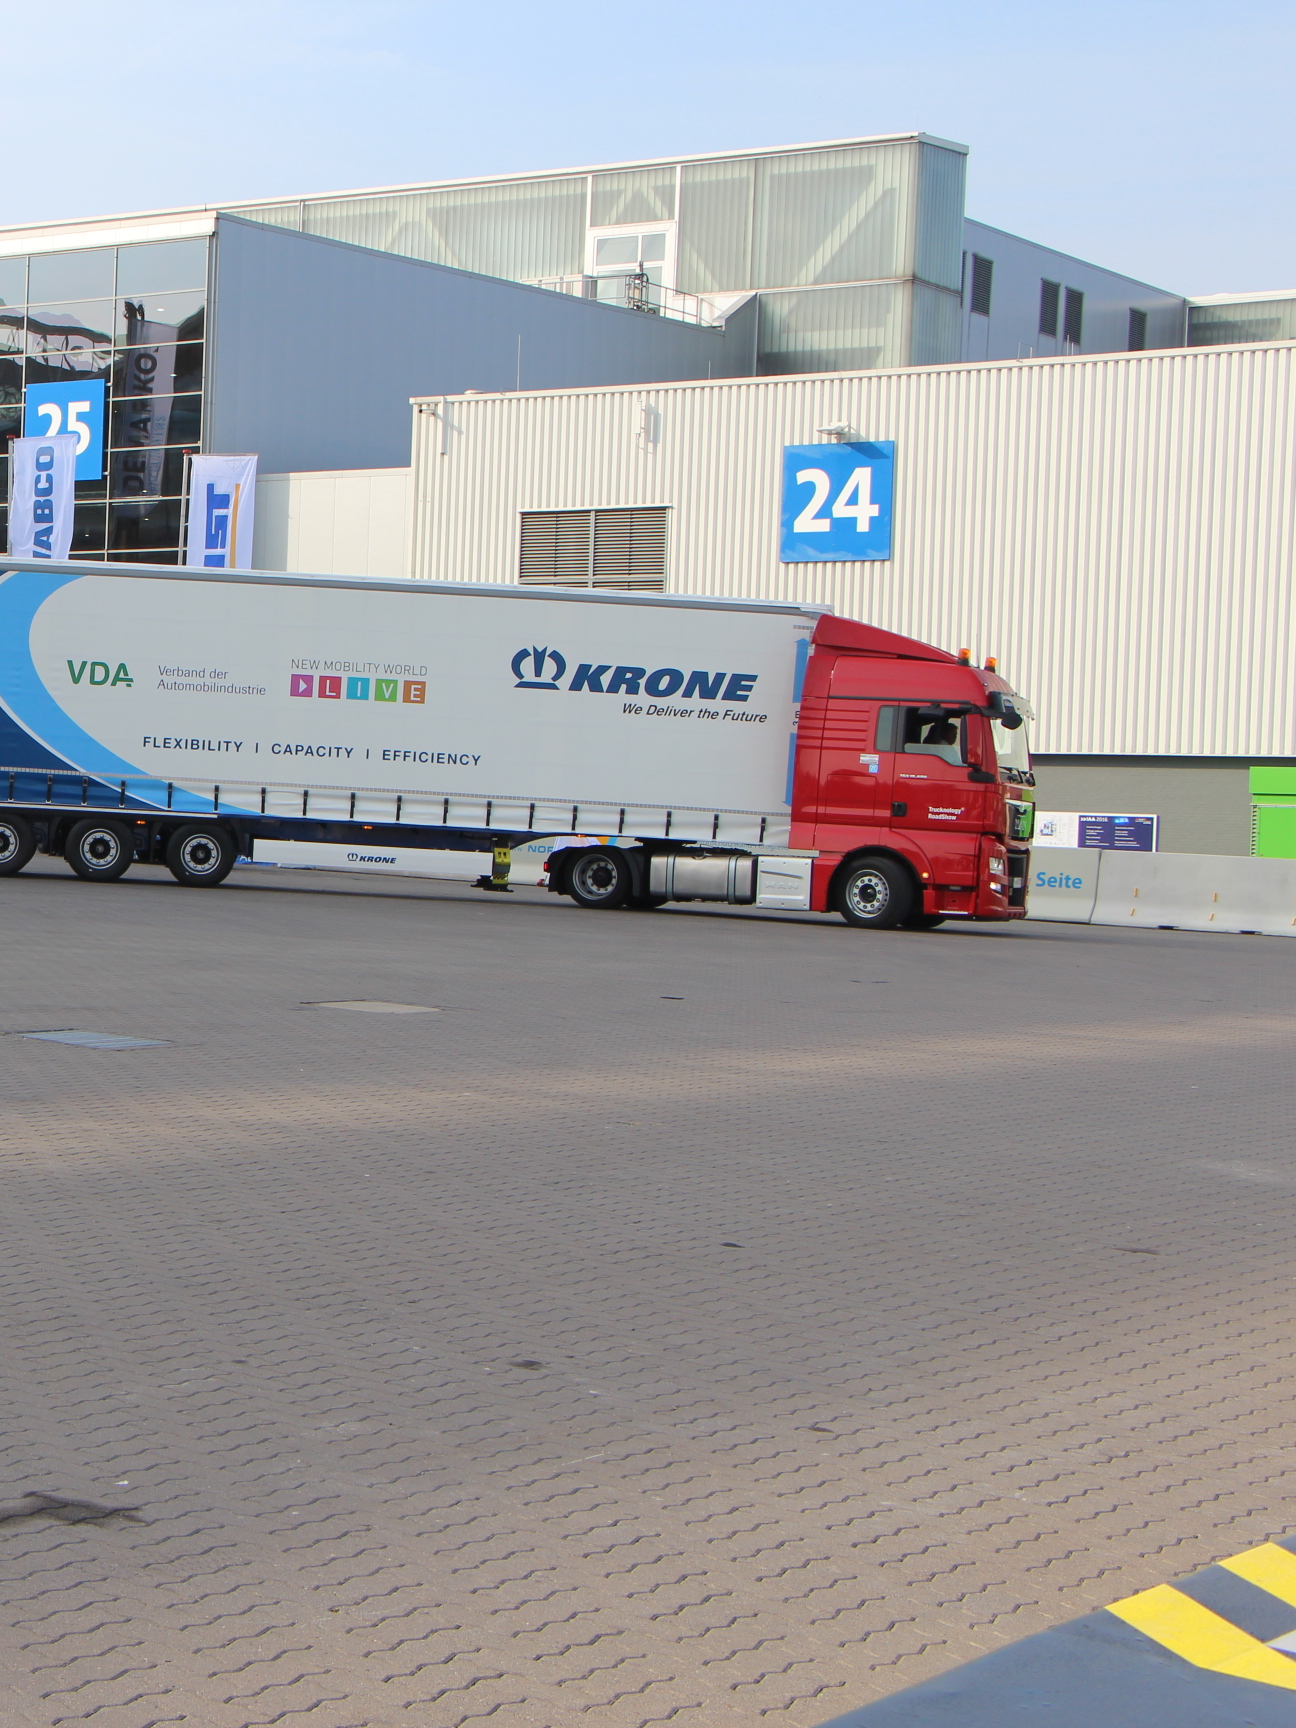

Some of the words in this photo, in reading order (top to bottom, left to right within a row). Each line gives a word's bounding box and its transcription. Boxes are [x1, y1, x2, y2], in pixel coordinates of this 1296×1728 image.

[37, 401, 91, 457] 25
[793, 466, 880, 533] 24
[67, 659, 134, 688] VDA
[158, 665, 205, 679] Verband
[209, 668, 228, 680] der
[291, 658, 320, 671] NEW
[323, 660, 380, 674] MOBILITY
[383, 663, 428, 677] WORLD
[157, 679, 266, 696] Automobilindustrie
[325, 679, 422, 701] LIVE
[568, 663, 758, 702] KRONE
[622, 702, 643, 716] We
[646, 704, 692, 719] Deliver
[697, 707, 719, 721] the
[722, 709, 768, 723] Future
[143, 736, 244, 753] FLEXIBILITY
[271, 743, 354, 759] CAPACITY
[381, 749, 482, 766] EFFICIENCY
[927, 813, 956, 821] RoadShow
[359, 855, 397, 865] KRONE
[1035, 871, 1083, 889] Seite
